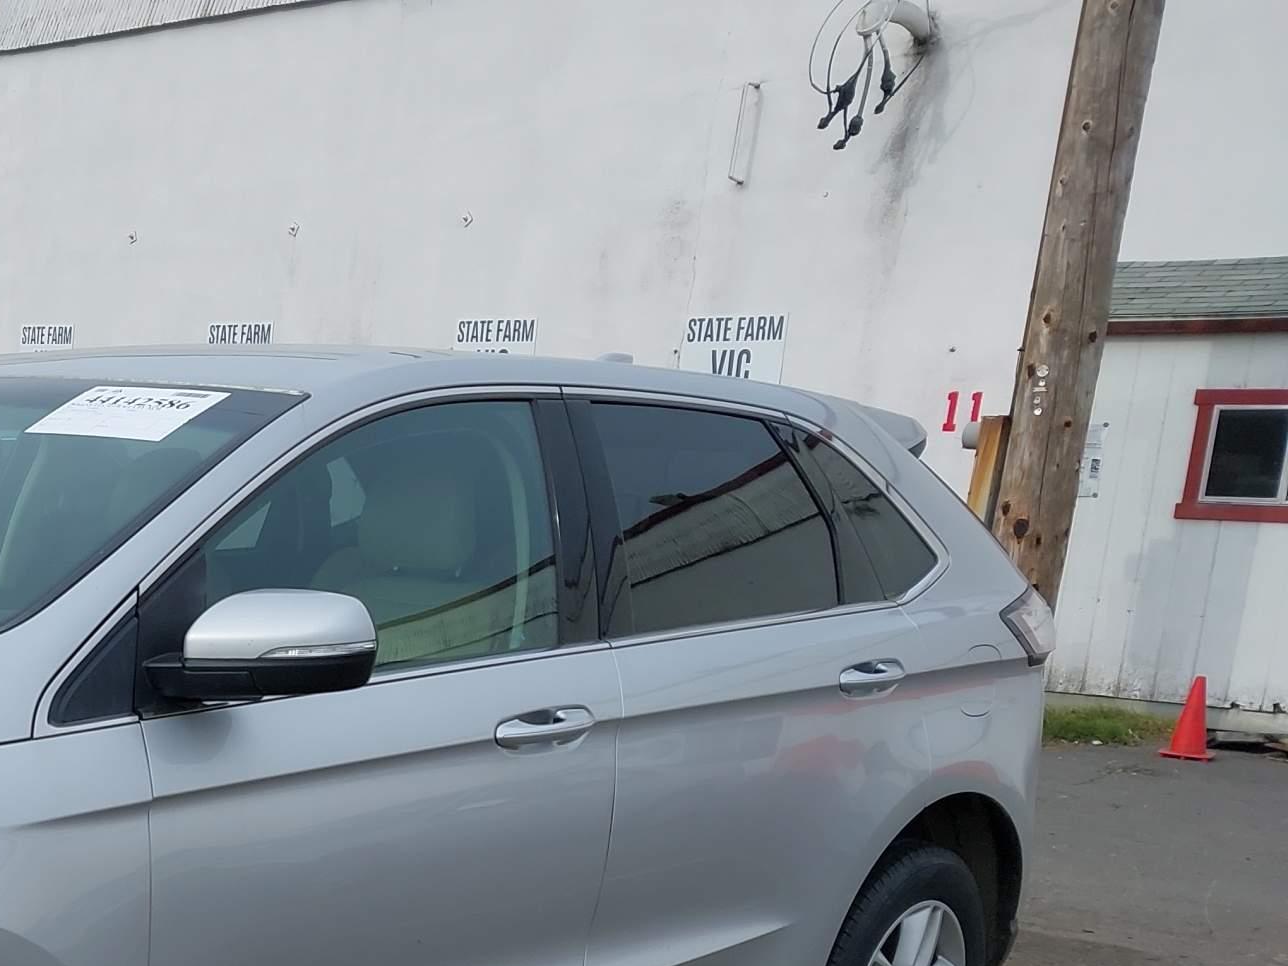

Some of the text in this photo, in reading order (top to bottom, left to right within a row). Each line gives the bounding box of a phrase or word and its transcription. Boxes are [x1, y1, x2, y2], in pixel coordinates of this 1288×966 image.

[21, 326, 72, 345] STATE FARM
[209, 323, 272, 345] STATE FARM
[457, 319, 535, 343] STATE FARM
[687, 315, 785, 343] STATE FARM
[711, 349, 751, 379] VIC
